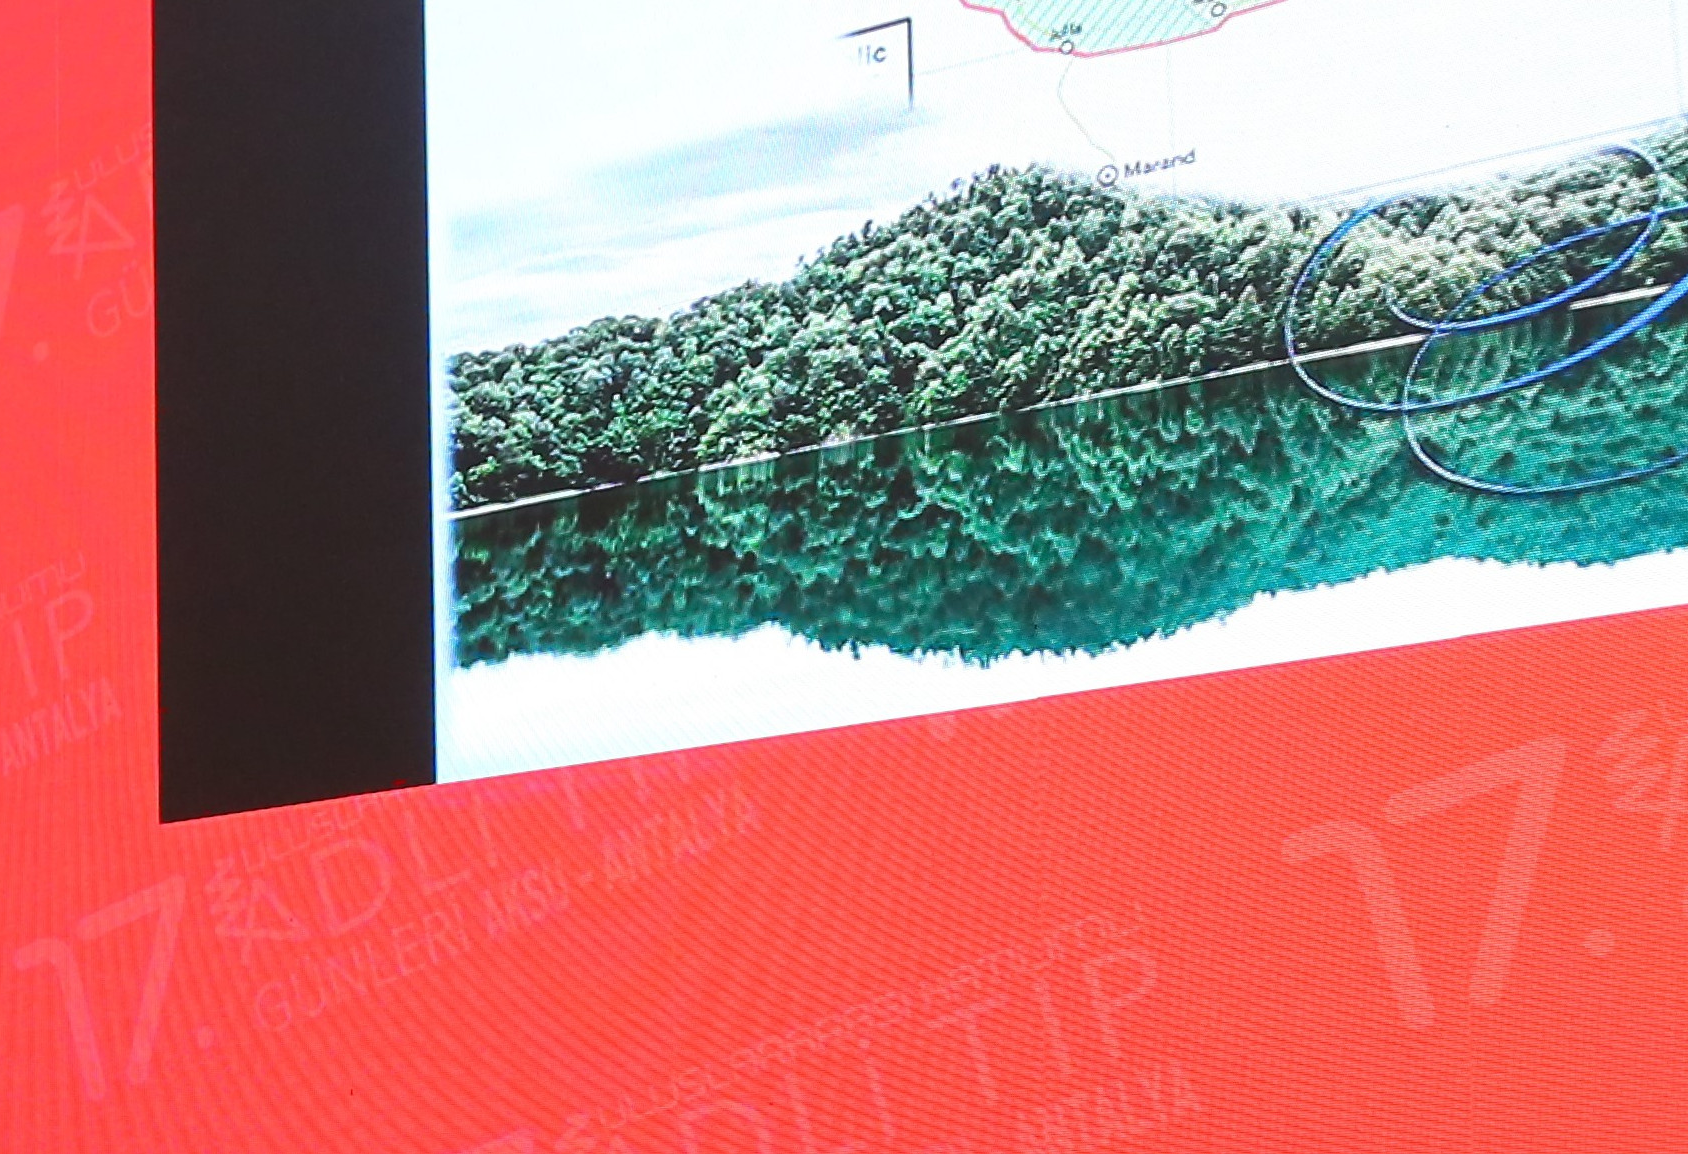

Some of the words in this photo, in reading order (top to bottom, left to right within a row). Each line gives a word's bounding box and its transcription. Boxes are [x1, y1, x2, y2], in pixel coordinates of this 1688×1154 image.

[1125, 149, 1196, 179] Marand
[1280, 734, 1615, 1029] 17.
[12, 874, 216, 1101] 17.
[925, 946, 1158, 1104] TIP
